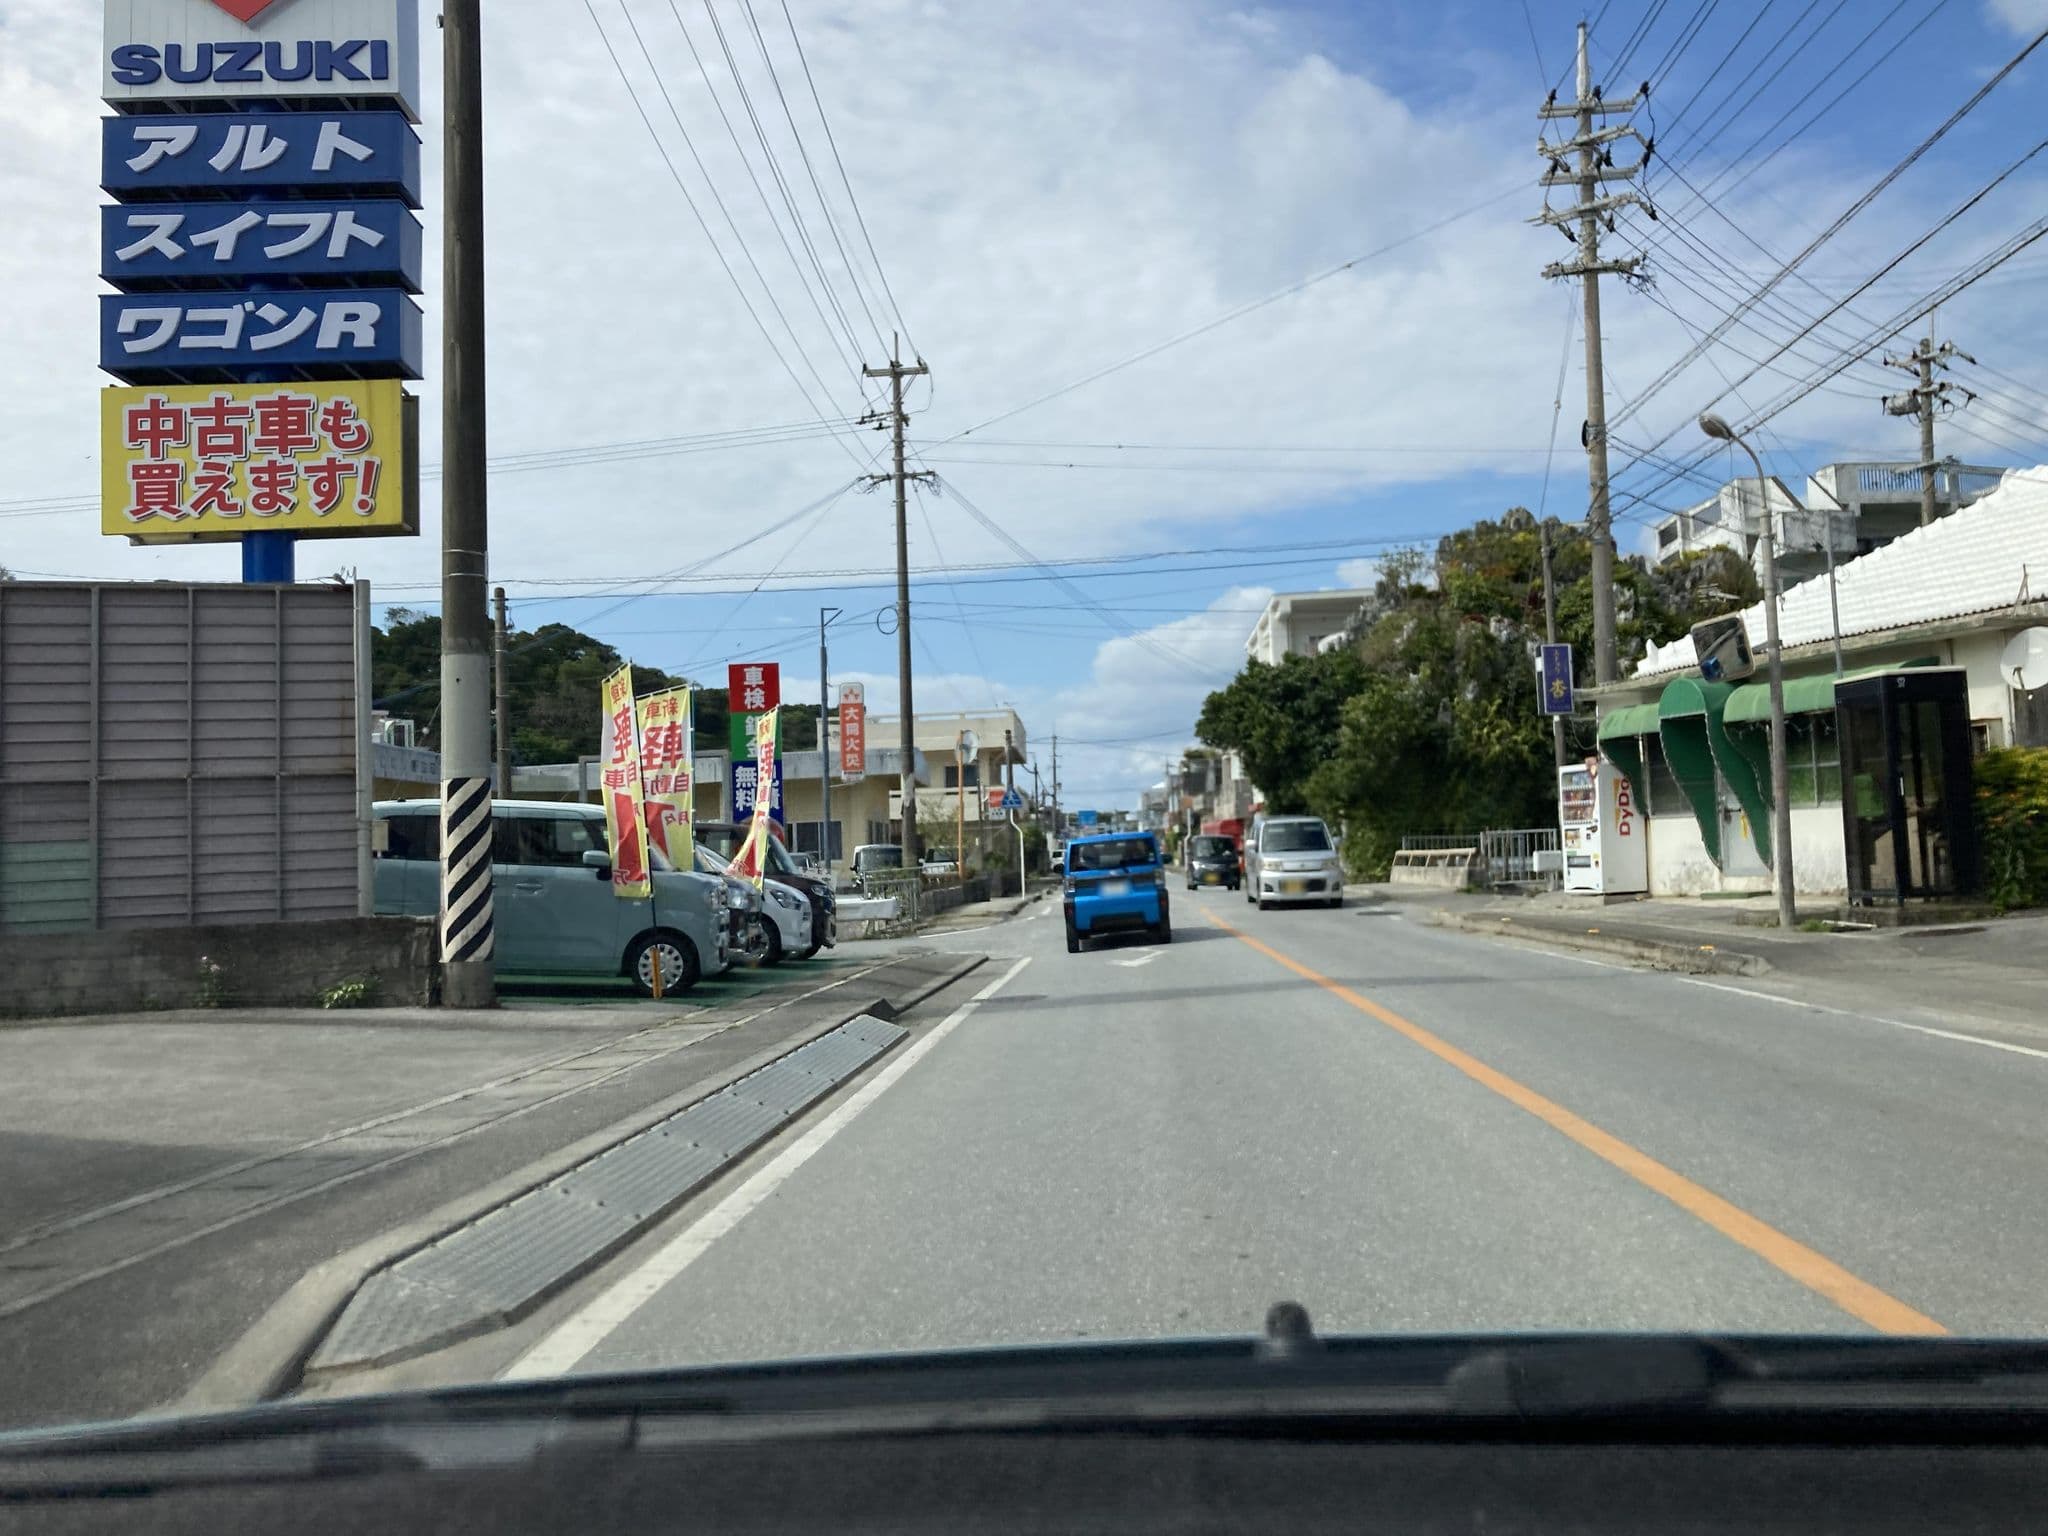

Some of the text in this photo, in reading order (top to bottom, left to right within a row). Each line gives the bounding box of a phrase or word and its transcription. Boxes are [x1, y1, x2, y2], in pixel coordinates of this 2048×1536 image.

[111, 40, 389, 85] SUZUKI
[125, 121, 375, 173] アルト
[115, 210, 385, 261] スイフト
[117, 301, 382, 353] ワゴンR
[125, 392, 373, 461] 中古車も
[126, 456, 380, 519] 買えます!
[743, 666, 766, 710] 車検
